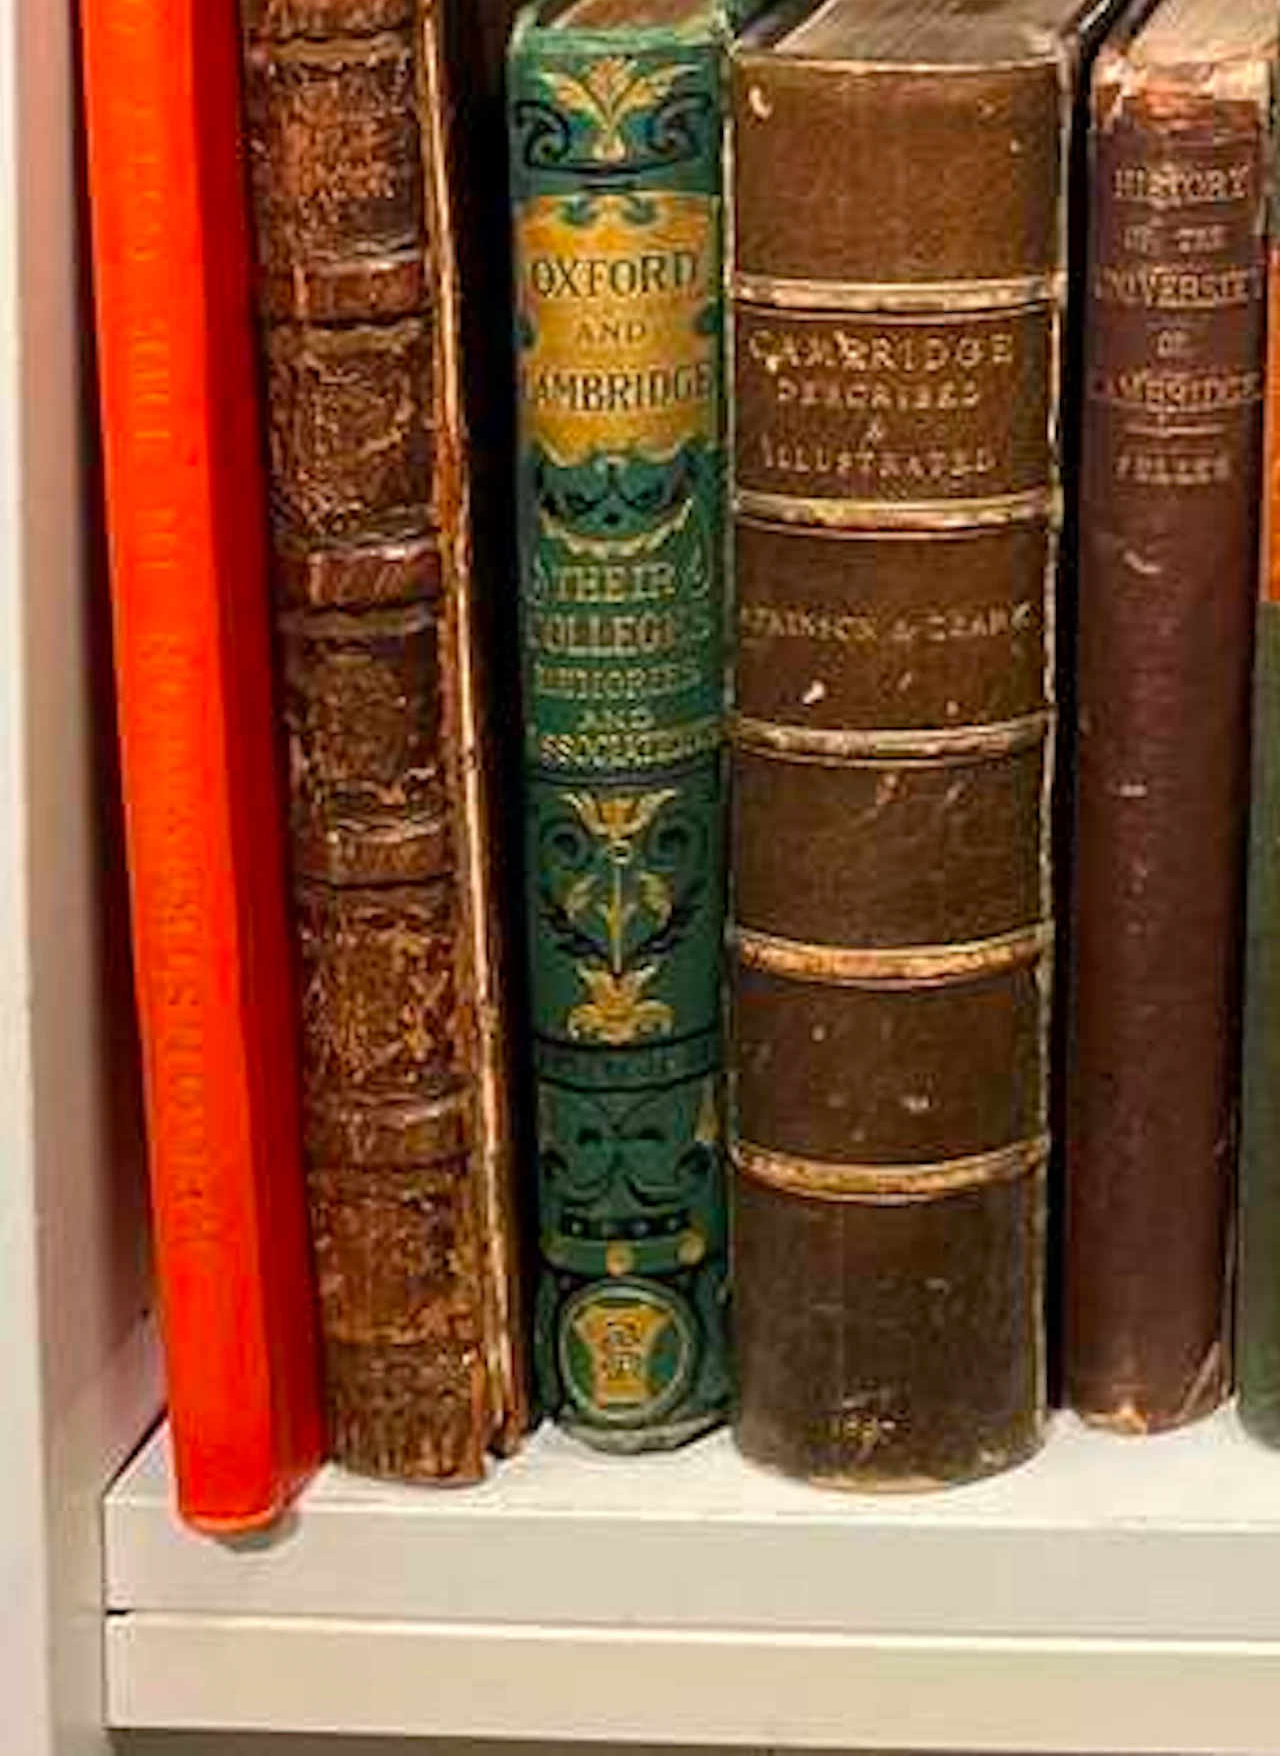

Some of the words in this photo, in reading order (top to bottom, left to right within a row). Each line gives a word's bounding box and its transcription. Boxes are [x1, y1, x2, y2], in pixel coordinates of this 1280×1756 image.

[1115, 165, 1249, 200] HISTORY
[531, 251, 698, 298] OXFORD
[576, 319, 648, 345] AND
[748, 330, 1014, 374] CAMBRIDGE
[556, 562, 677, 602] THEIR
